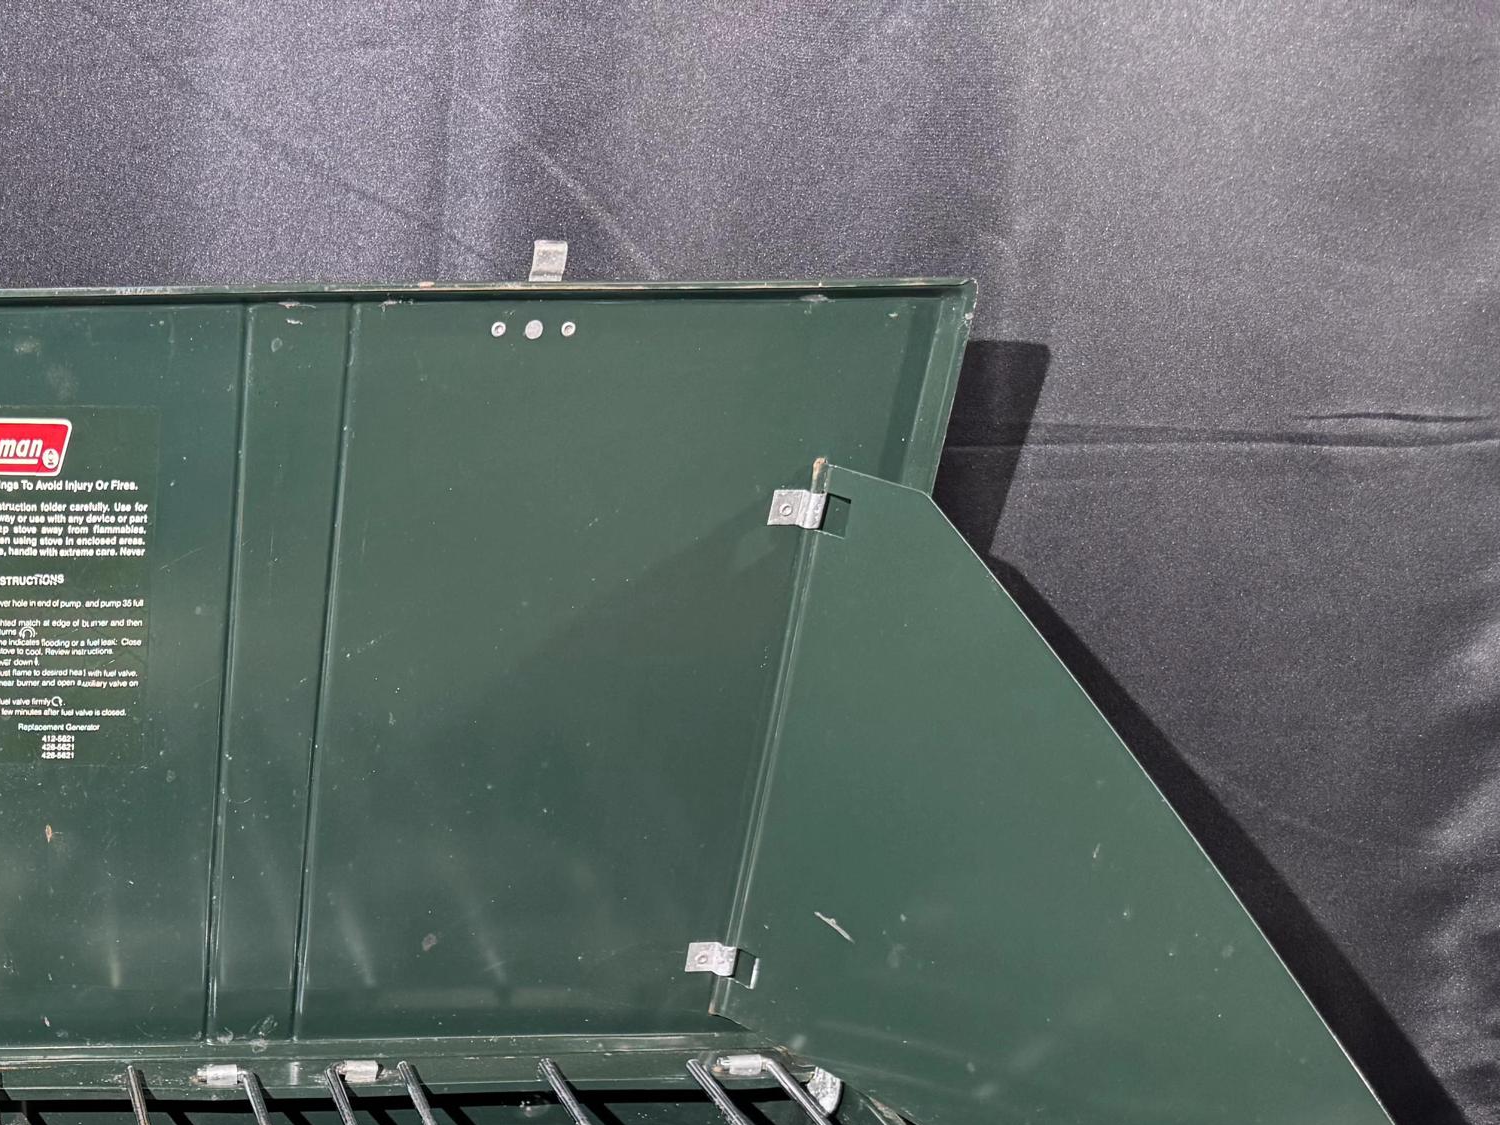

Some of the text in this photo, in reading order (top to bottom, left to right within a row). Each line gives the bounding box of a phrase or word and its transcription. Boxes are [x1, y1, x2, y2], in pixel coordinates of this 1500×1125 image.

[21, 479, 33, 490] To
[36, 479, 62, 490] Avoid
[65, 479, 93, 492] Injury
[96, 479, 109, 490] Or
[111, 479, 138, 490] Fires.
[40, 501, 66, 511] folder
[70, 501, 110, 513] carefully.
[114, 501, 131, 511] Use
[134, 501, 148, 511] for
[17, 514, 27, 524] or
[29, 514, 45, 524] use
[47, 513, 66, 524] with
[68, 514, 84, 525] any
[86, 514, 115, 524] device
[117, 514, 127, 524] or
[129, 514, 148, 525] part
[18, 723, 100, 733] Replacement Generator
